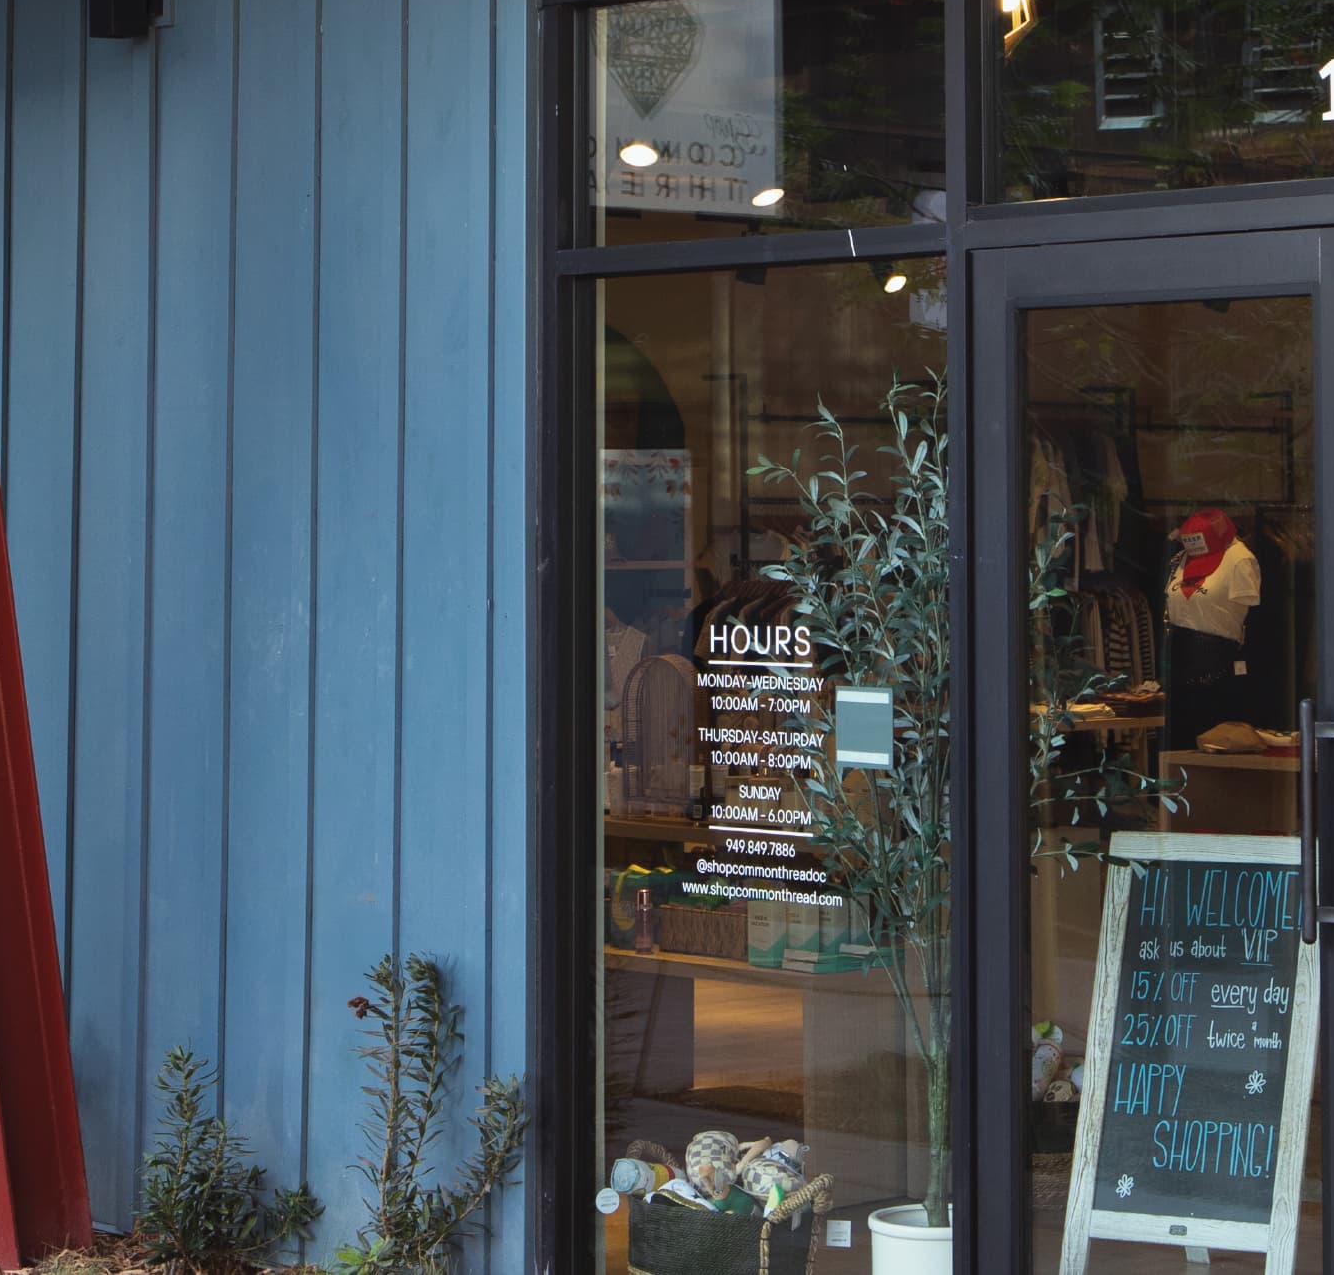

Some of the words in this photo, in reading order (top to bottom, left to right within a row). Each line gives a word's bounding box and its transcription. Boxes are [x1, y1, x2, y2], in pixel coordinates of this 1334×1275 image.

[710, 624, 811, 657] HOURS
[697, 673, 825, 692] MONDAY-WEDNESDAY
[711, 696, 759, 711] 10:00AM
[768, 698, 811, 714] 7:00PM
[698, 727, 825, 748] THURSDAY-SATURDAY
[711, 751, 759, 766] 10:00AM
[768, 753, 812, 770] 8:00PM
[739, 785, 782, 801] SUNDAY
[711, 805, 759, 821] 10:00AM
[725, 838, 796, 858] 949.849.7886
[697, 859, 827, 883] @shopcommonthreadoc
[682, 882, 843, 907] www.shopcommonthread.com
[1139, 936, 1161, 961] ask
[1170, 939, 1185, 957] us
[1190, 934, 1227, 959] about
[1130, 970, 1166, 1003] 15%
[1170, 971, 1201, 1005] OFF
[1210, 981, 1258, 1015] every
[1263, 977, 1290, 1015] day
[1120, 1013, 1165, 1048] 25%
[1164, 1013, 1198, 1049] OFF
[1206, 1019, 1246, 1049] twice
[1251, 1021, 1258, 1032] a
[1253, 1031, 1283, 1050] month
[1114, 1062, 1187, 1118] HAPPY
